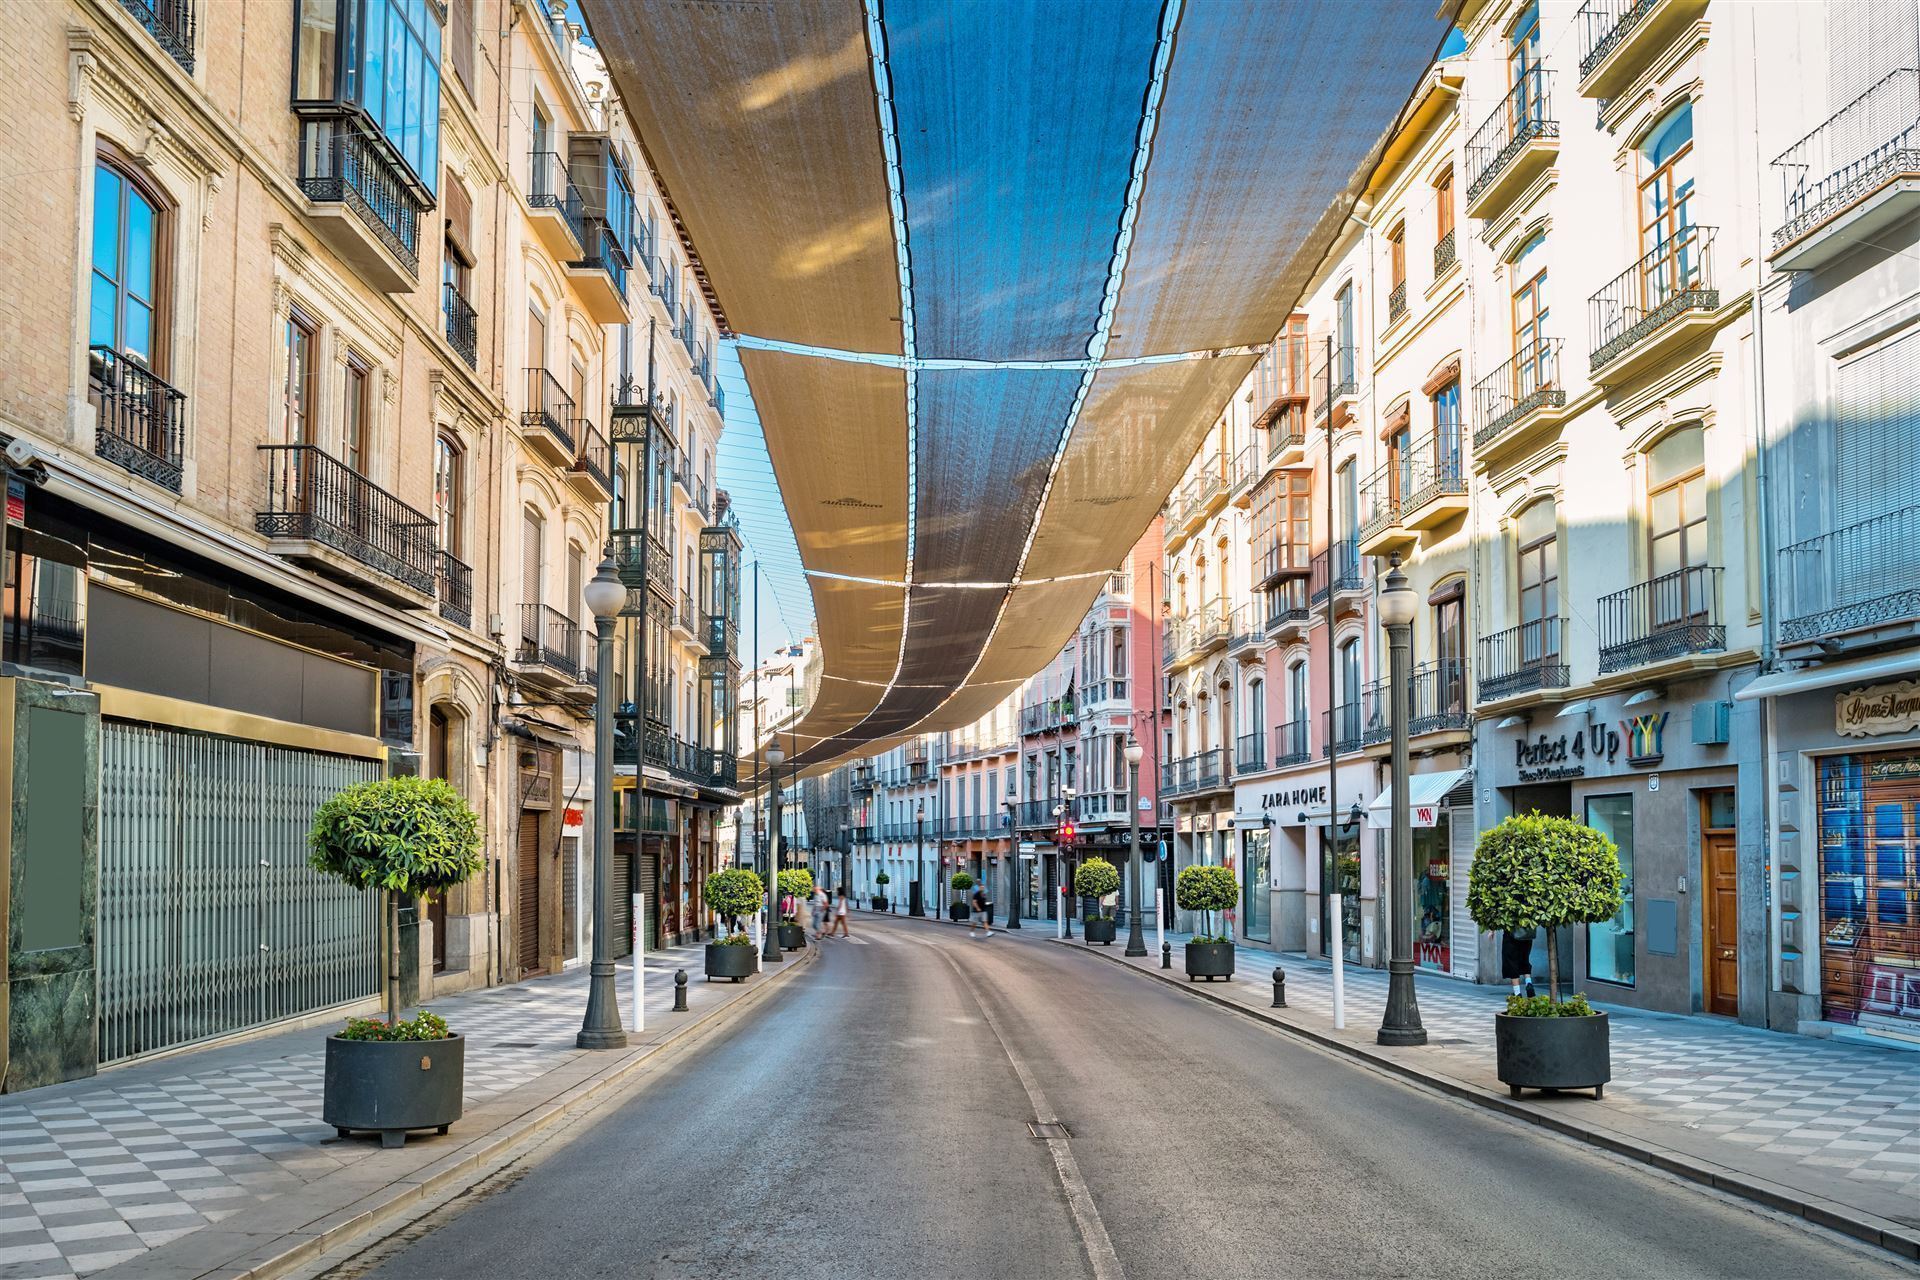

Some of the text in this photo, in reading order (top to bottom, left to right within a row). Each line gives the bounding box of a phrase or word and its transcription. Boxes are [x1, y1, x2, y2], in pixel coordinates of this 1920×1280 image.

[1515, 722, 1620, 767] Perfect 4 Up
[1261, 786, 1327, 810] ZARA HOME
